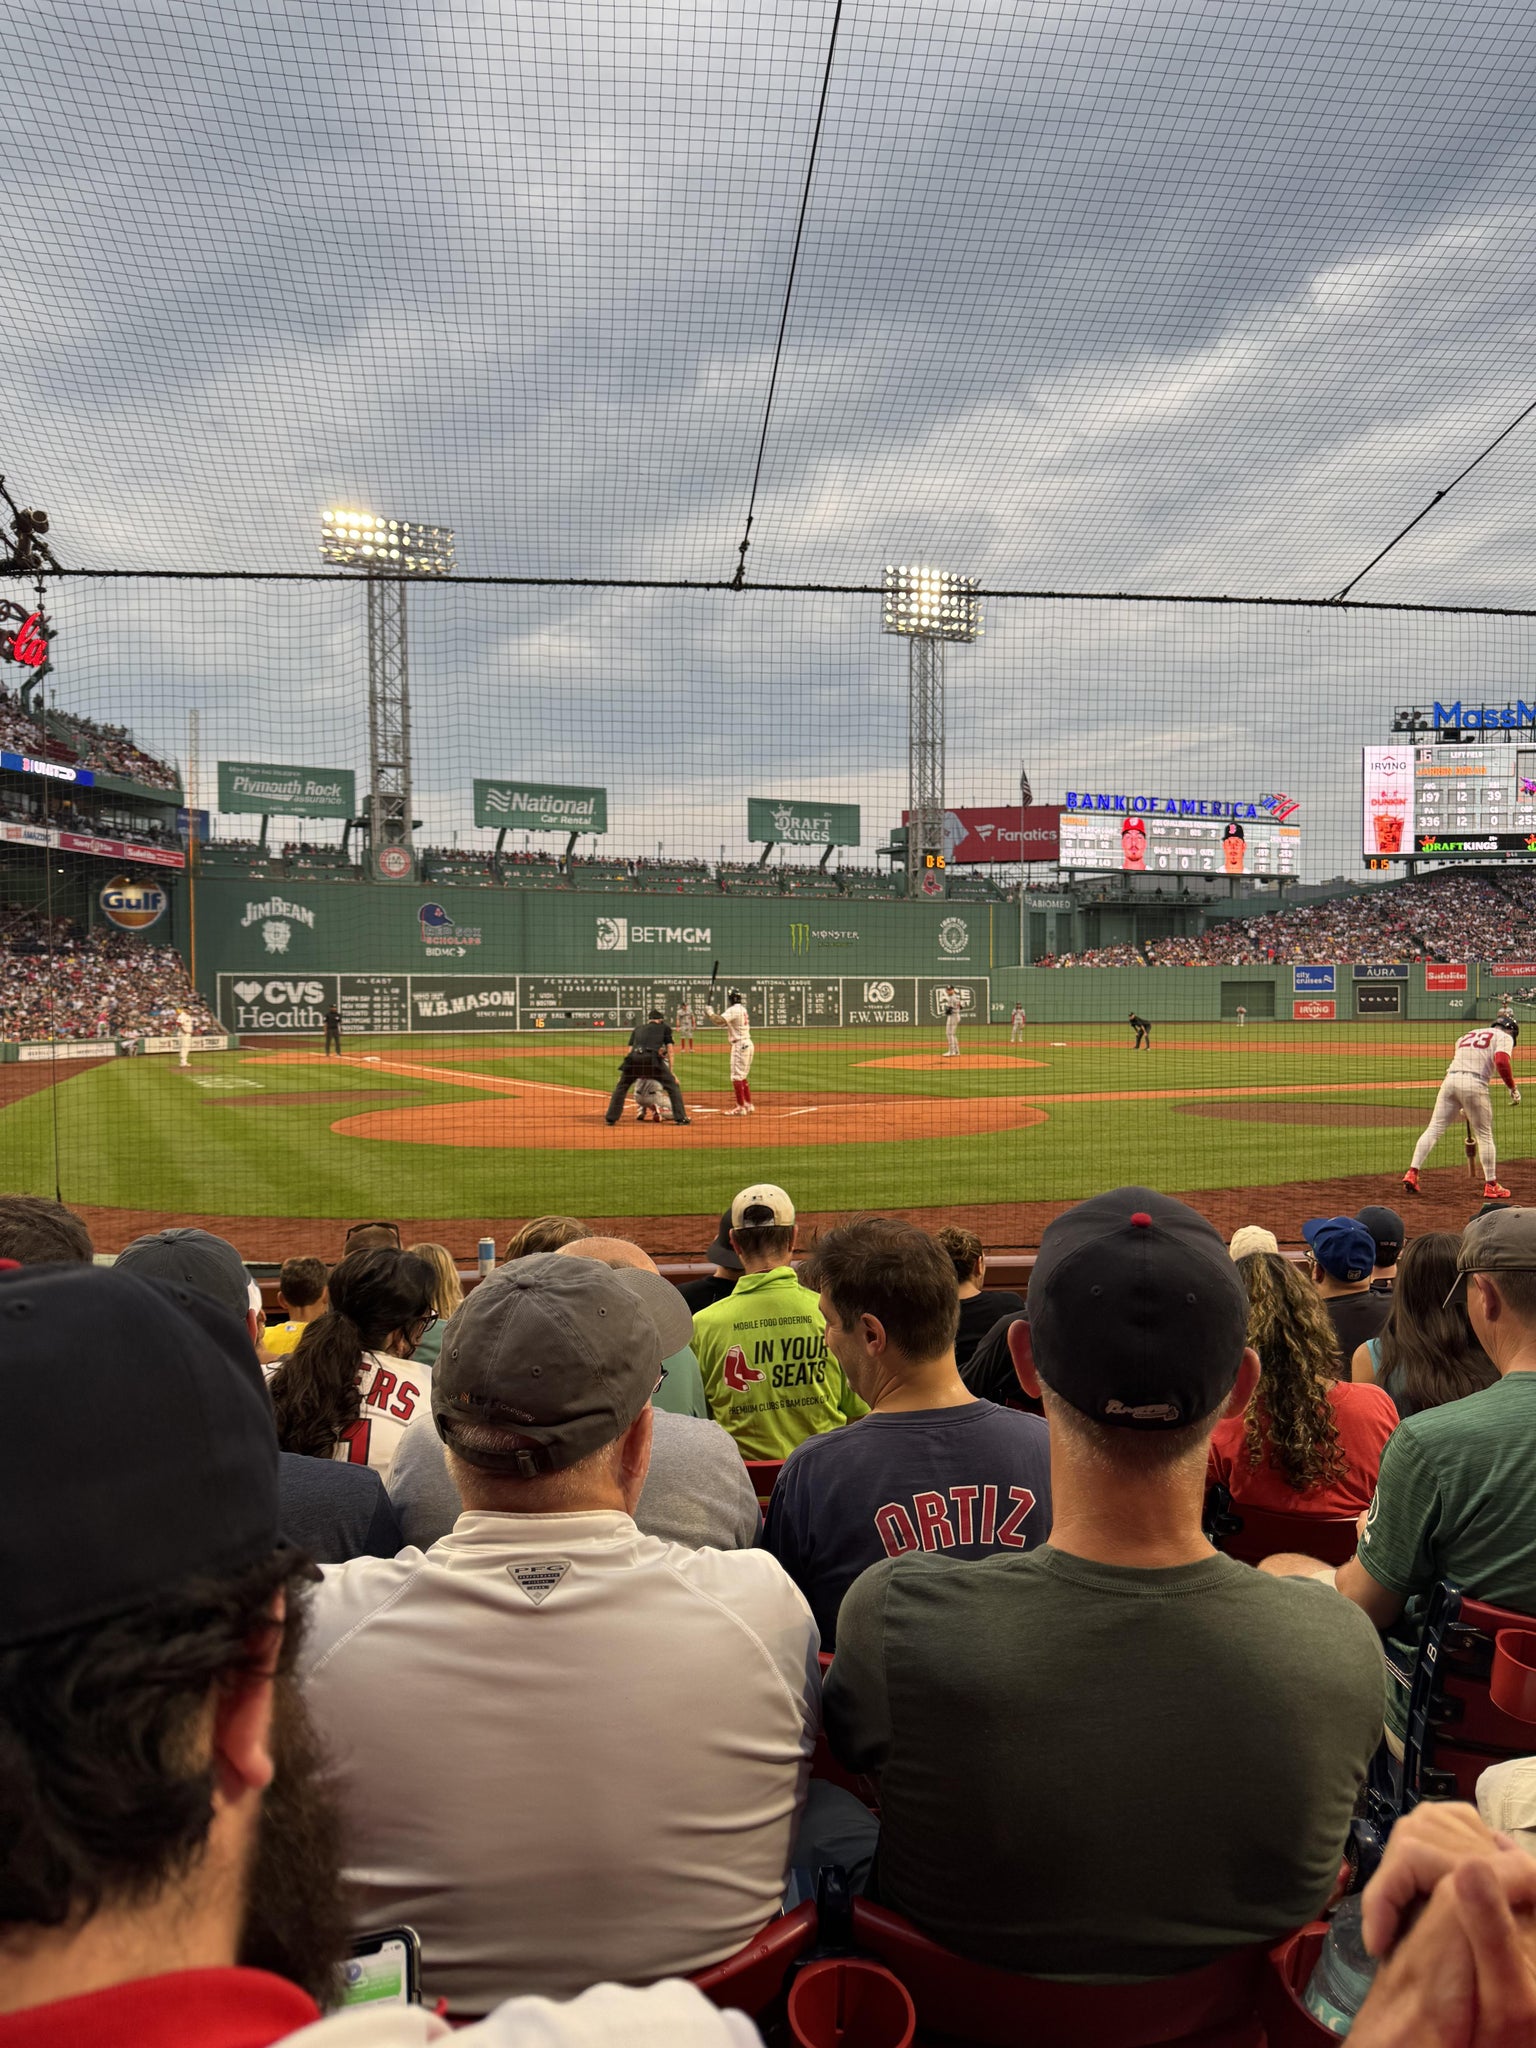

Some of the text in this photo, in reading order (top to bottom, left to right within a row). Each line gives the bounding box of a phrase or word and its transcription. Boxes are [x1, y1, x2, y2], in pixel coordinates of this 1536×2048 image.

[1371, 762, 1407, 770] IRVING
[233, 776, 342, 797] Plymouth Rock
[511, 792, 594, 815] National
[1457, 792, 1467, 802] 12
[1487, 791, 1501, 801] 39
[1066, 791, 1258, 819] BANK OF AMERICA
[541, 814, 592, 826] Car Rental
[775, 816, 832, 831] DRAFT
[1419, 817, 1440, 827] 336
[1457, 817, 1468, 827] 12
[1490, 816, 1498, 825] 0
[782, 828, 830, 842] KINGS
[996, 827, 1057, 842] Fanatics
[1422, 842, 1498, 853] DRAFTKINGS
[1159, 856, 1211, 870] 0 0 2
[103, 891, 162, 911] Gulf
[1032, 900, 1071, 909] ABIOMED
[426, 937, 482, 945] SCHOLARS
[631, 927, 711, 943] BETMGM
[812, 930, 859, 939] MONSTER
[425, 947, 456, 957] BIDMC
[1428, 972, 1466, 980] Safelite
[264, 981, 325, 1004] CVS
[237, 1006, 323, 1029] Health
[850, 1011, 910, 1023] F.W. WEBB
[1459, 1032, 1494, 1049] 23
[733, 1315, 813, 1332] MOBILE FOOD ORDERING
[754, 1339, 775, 1364] IN
[772, 1360, 827, 1389] SEATS
[759, 1401, 780, 1412] CLUBS
[801, 1396, 820, 1407] DECK
[874, 1484, 1036, 1558] ORTIZ
[1427, 1642, 1437, 1663] B
